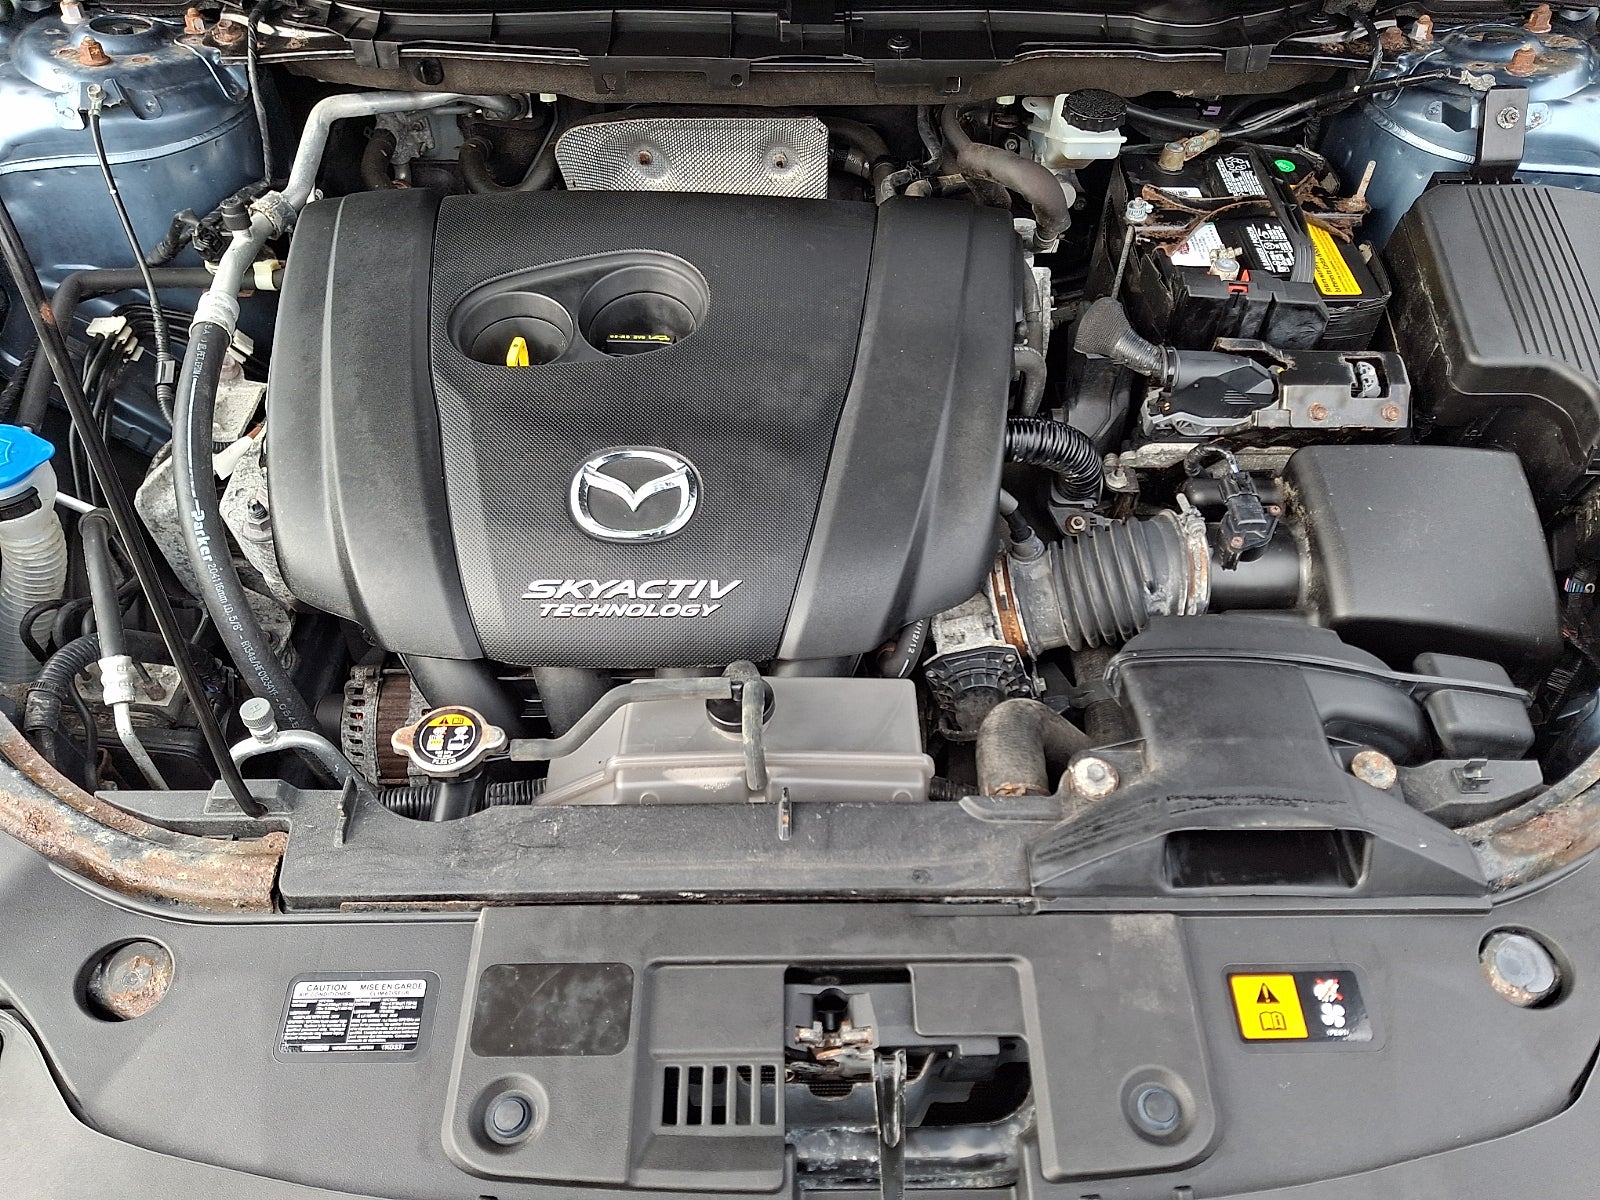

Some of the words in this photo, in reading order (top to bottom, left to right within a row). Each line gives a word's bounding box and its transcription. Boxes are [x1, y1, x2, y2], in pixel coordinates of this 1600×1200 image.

[191, 510, 213, 562] Parker
[521, 579, 743, 600] SKYACTIV
[540, 603, 723, 618] TECHNOLOGY
[306, 984, 348, 992] CAUTION
[360, 983, 380, 991] MISE
[381, 983, 393, 991] EN
[394, 982, 423, 990] GARDE
